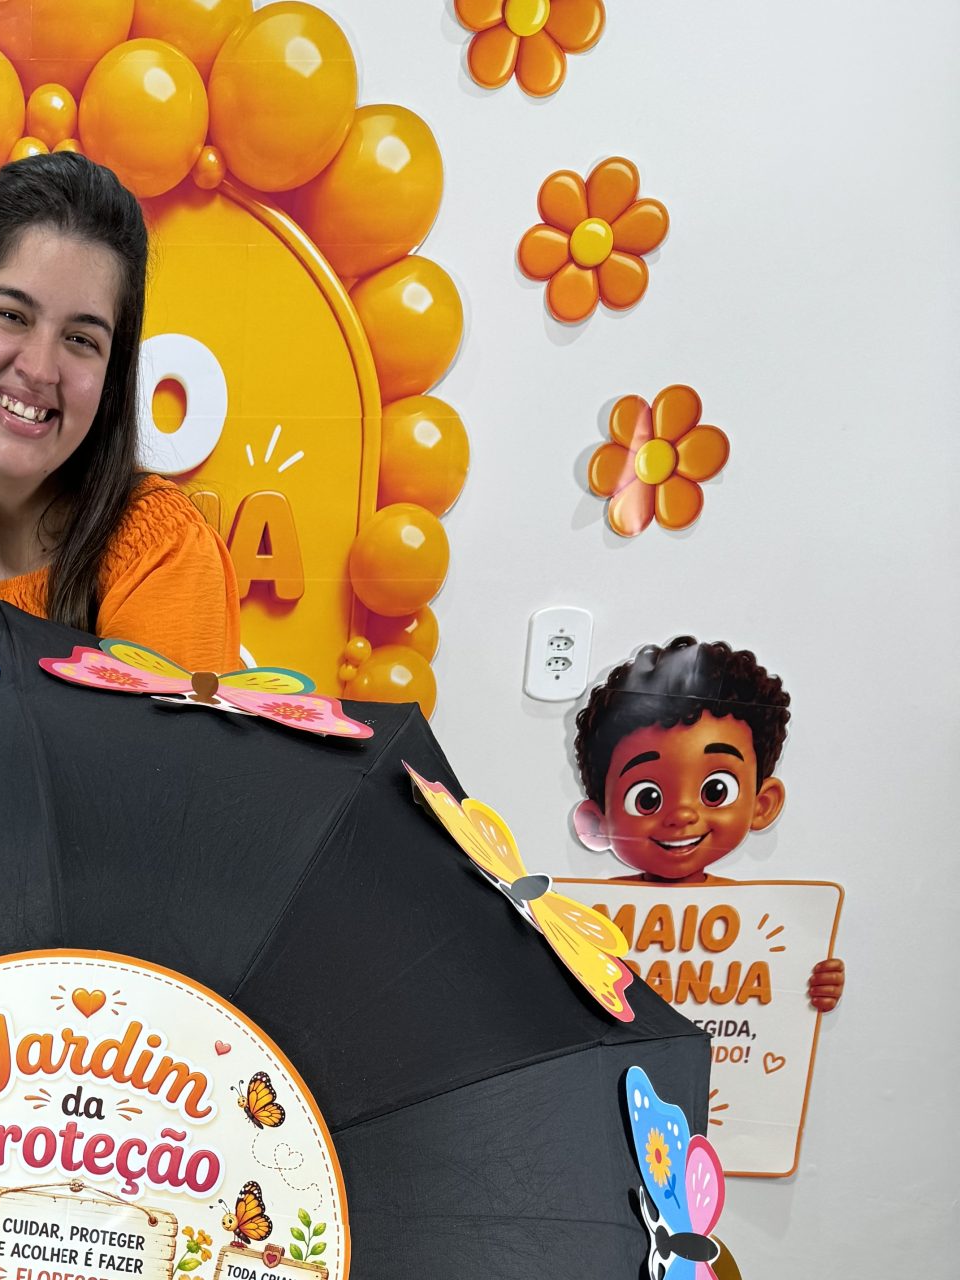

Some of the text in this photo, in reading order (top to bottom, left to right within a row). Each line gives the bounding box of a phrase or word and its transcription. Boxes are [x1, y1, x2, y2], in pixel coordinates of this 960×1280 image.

[61, 1085, 106, 1120] da
[2, 1217, 146, 1251] CUIDAR, PROTEGER
[10, 1242, 78, 1266] ACOLHER
[84, 1246, 94, 1267] É
[99, 1253, 144, 1275] FAZER
